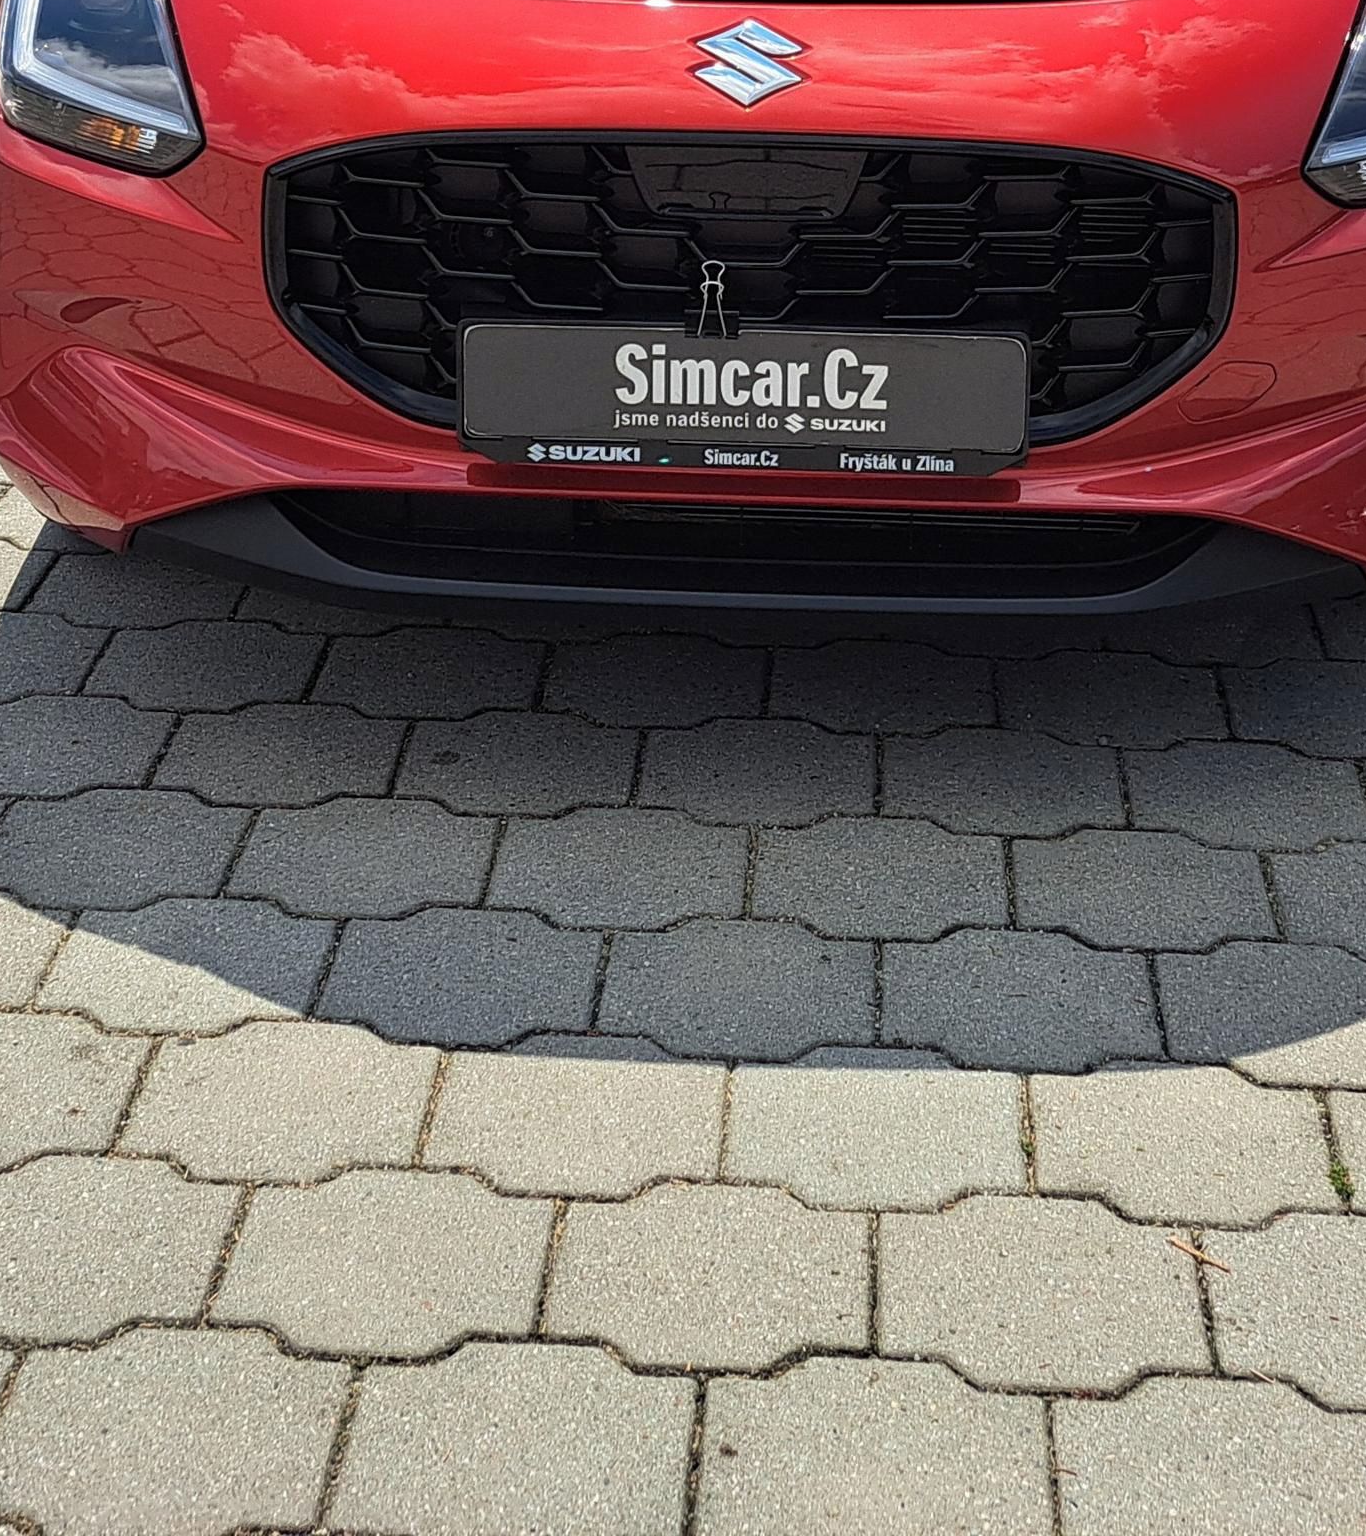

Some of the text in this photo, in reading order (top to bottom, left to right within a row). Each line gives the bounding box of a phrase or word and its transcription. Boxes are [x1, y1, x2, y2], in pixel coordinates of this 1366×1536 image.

[614, 343, 889, 410] Simcar.Cz
[613, 409, 886, 432] jsme nadšenci do SUZUKI
[548, 444, 779, 467] SUZUKI Simcar.Cz
[839, 452, 955, 473] Fryšták u Zlína
